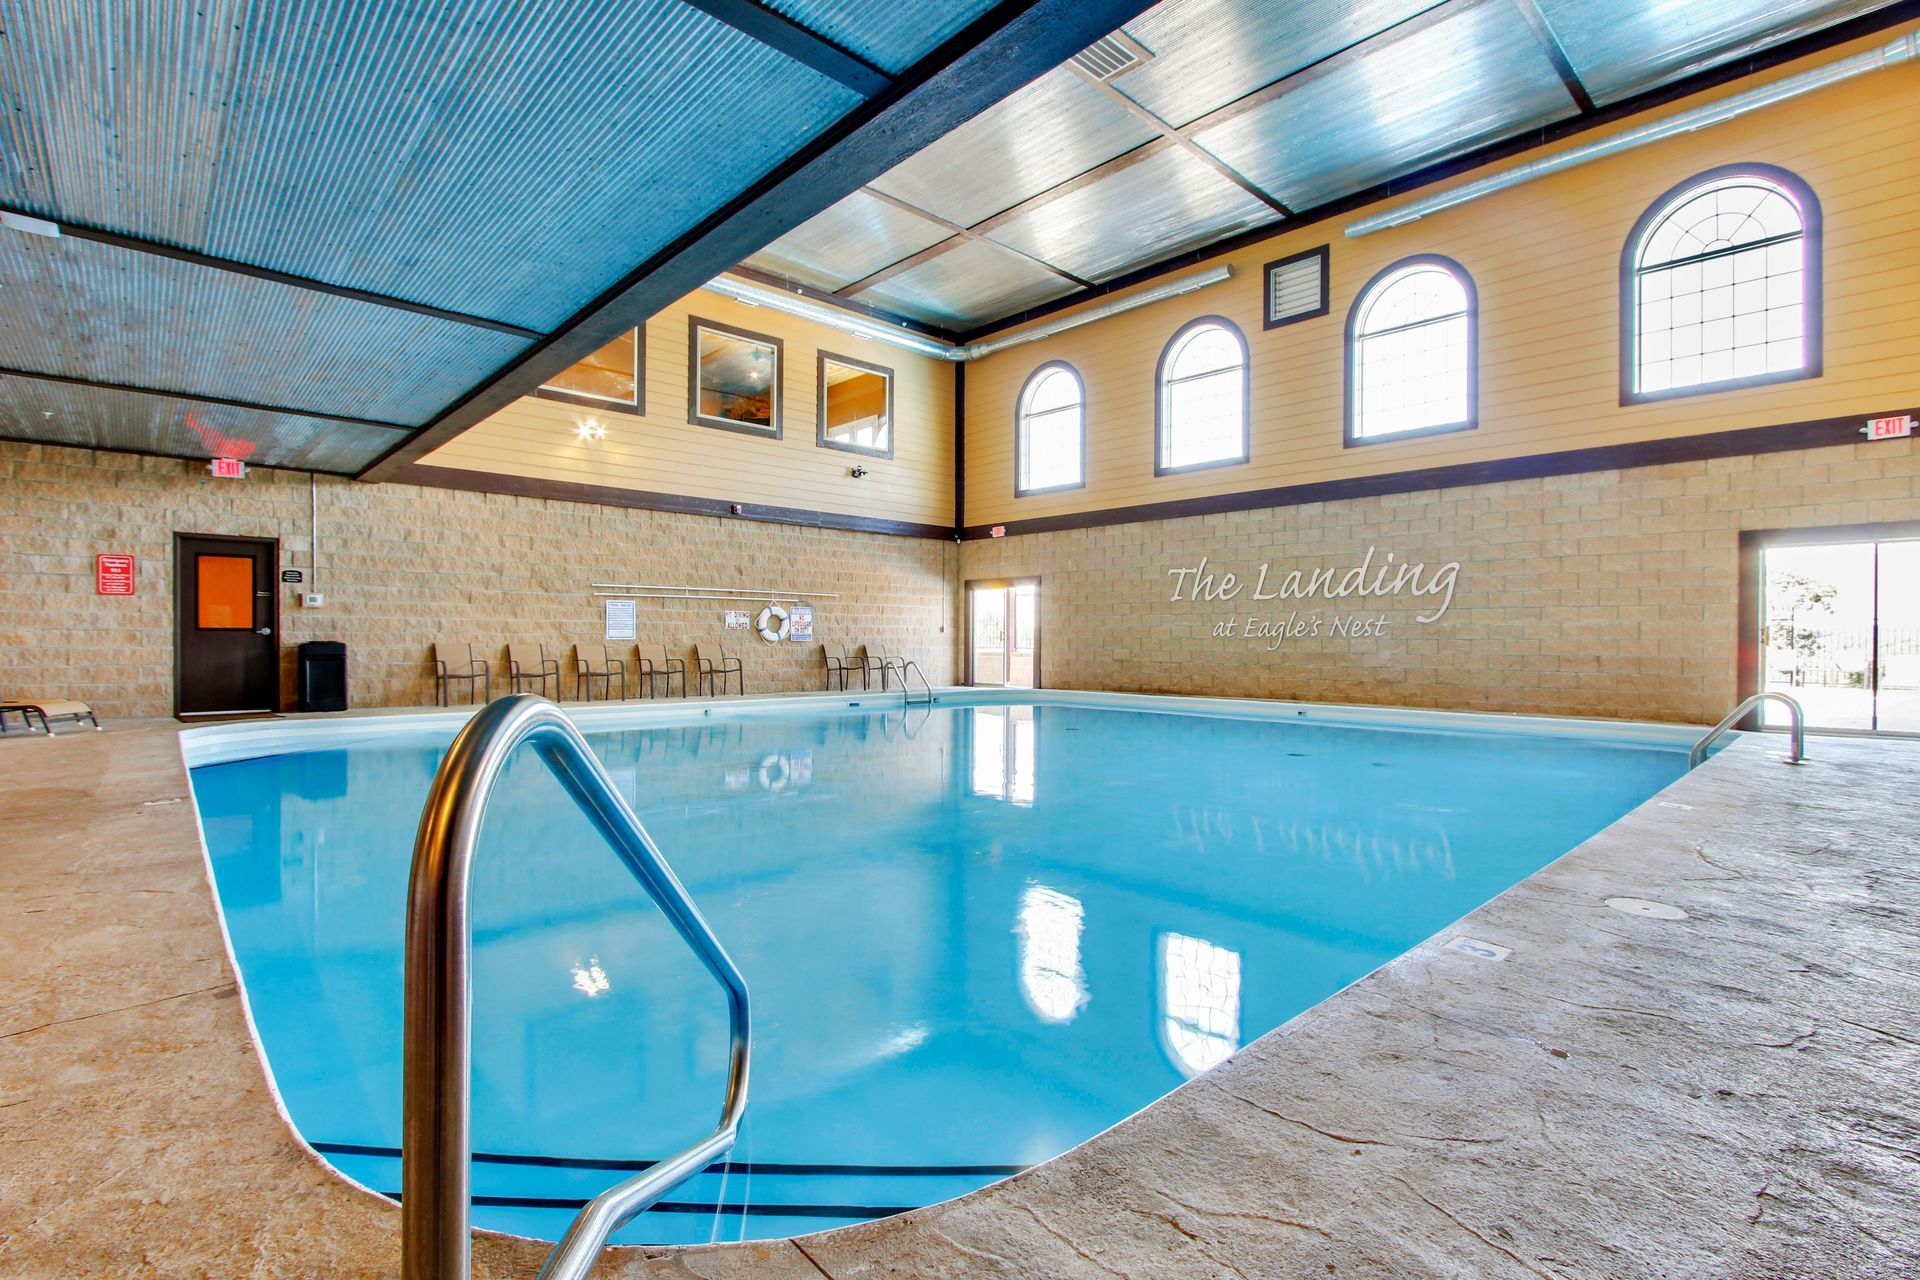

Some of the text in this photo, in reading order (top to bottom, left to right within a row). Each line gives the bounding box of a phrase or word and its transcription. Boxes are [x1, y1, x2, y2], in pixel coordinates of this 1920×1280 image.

[1875, 417, 1904, 437] EXIT
[217, 461, 240, 476] EXIT
[1168, 545, 1461, 624] The Landing
[1212, 611, 1391, 651] at Eagle's Nest
